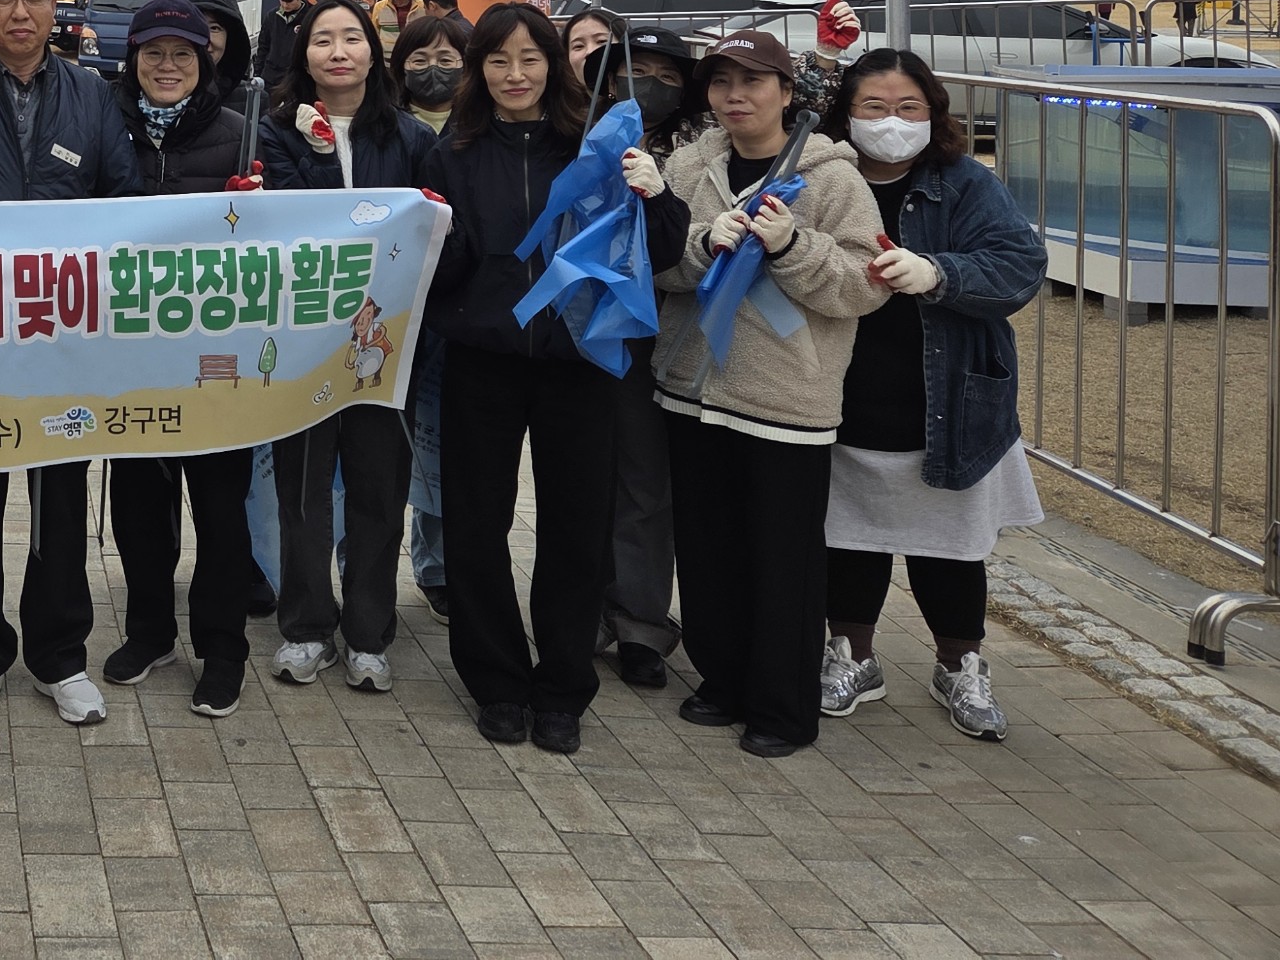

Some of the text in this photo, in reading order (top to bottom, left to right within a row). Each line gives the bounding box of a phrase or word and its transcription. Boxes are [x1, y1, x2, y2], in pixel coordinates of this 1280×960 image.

[13, 251, 98, 339] 맞이
[109, 246, 284, 334] 환경정화
[290, 243, 374, 326] 활동
[47, 421, 82, 437] STAY 영덕
[103, 405, 182, 435] 강구면
